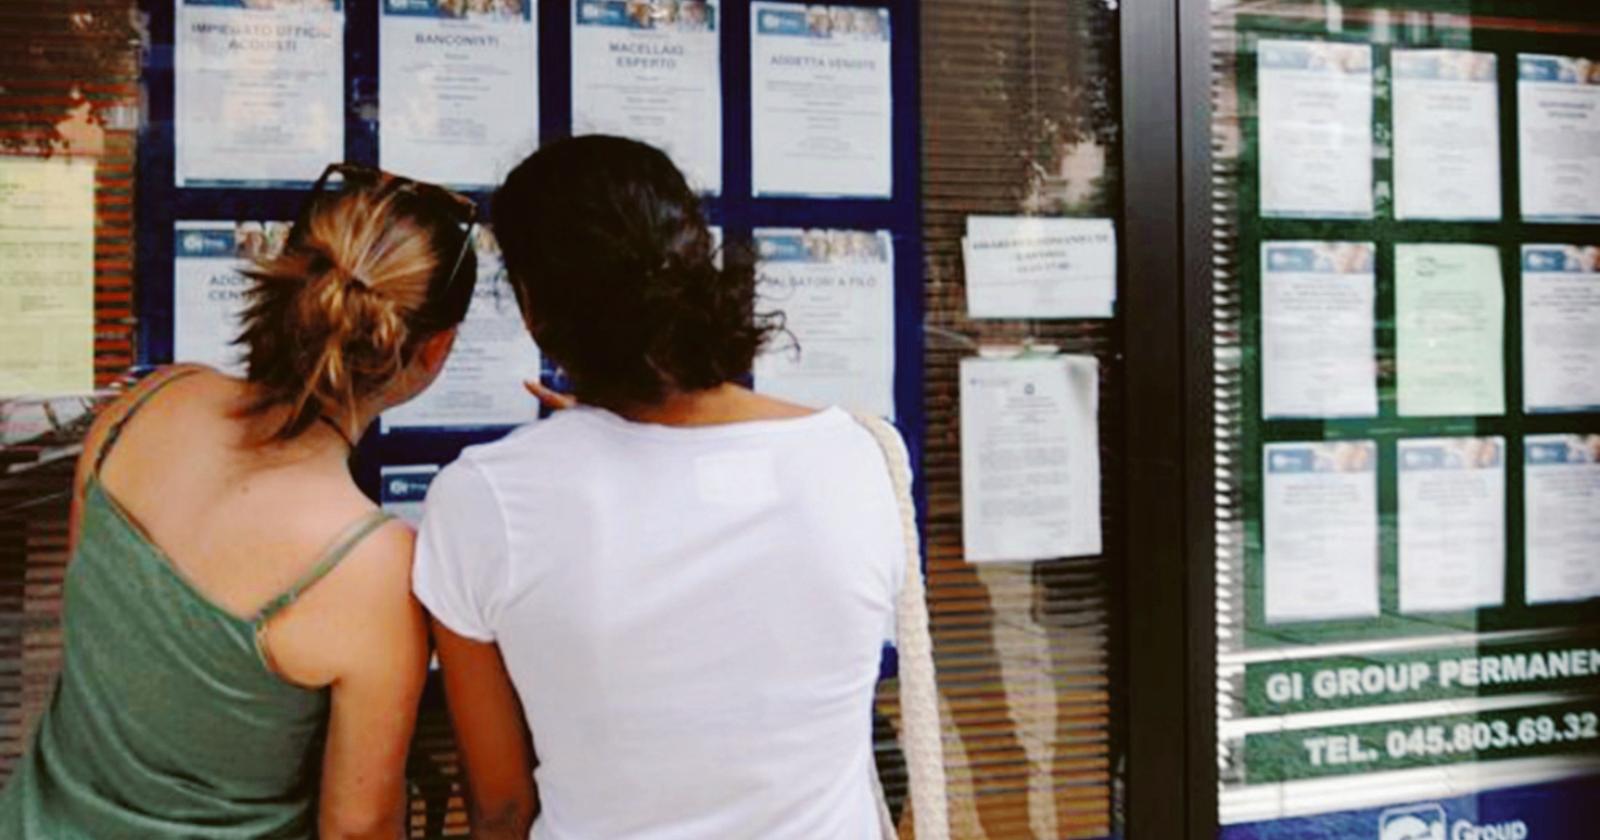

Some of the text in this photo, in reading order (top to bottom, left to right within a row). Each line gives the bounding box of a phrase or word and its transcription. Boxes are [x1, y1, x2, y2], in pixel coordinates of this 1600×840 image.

[1265, 672, 1304, 703] GI
[1312, 663, 1431, 698] GROUP
[1305, 712, 1598, 765] TEL. 045.803.69.32
